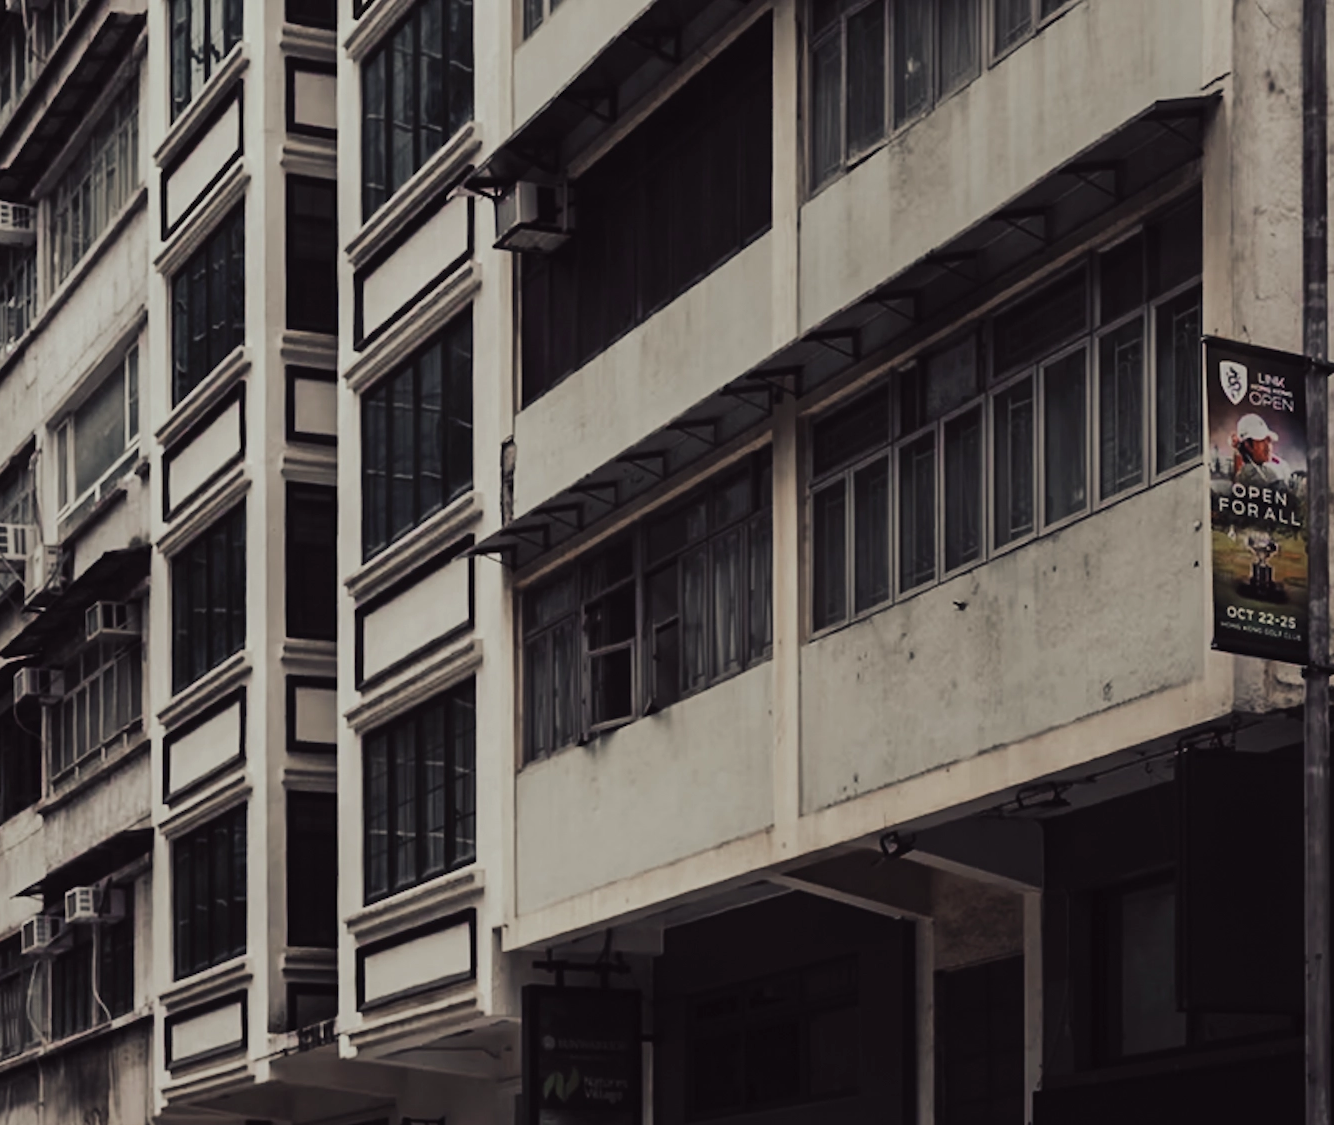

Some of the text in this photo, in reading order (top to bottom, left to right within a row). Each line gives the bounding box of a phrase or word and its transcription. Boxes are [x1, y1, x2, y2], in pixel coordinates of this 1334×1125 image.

[1257, 372, 1287, 388] LINK
[1249, 391, 1295, 413] OPEN
[1232, 482, 1287, 507] OPEN
[1219, 497, 1302, 527] FOR ALL
[1227, 605, 1298, 630] OCT 22-25
